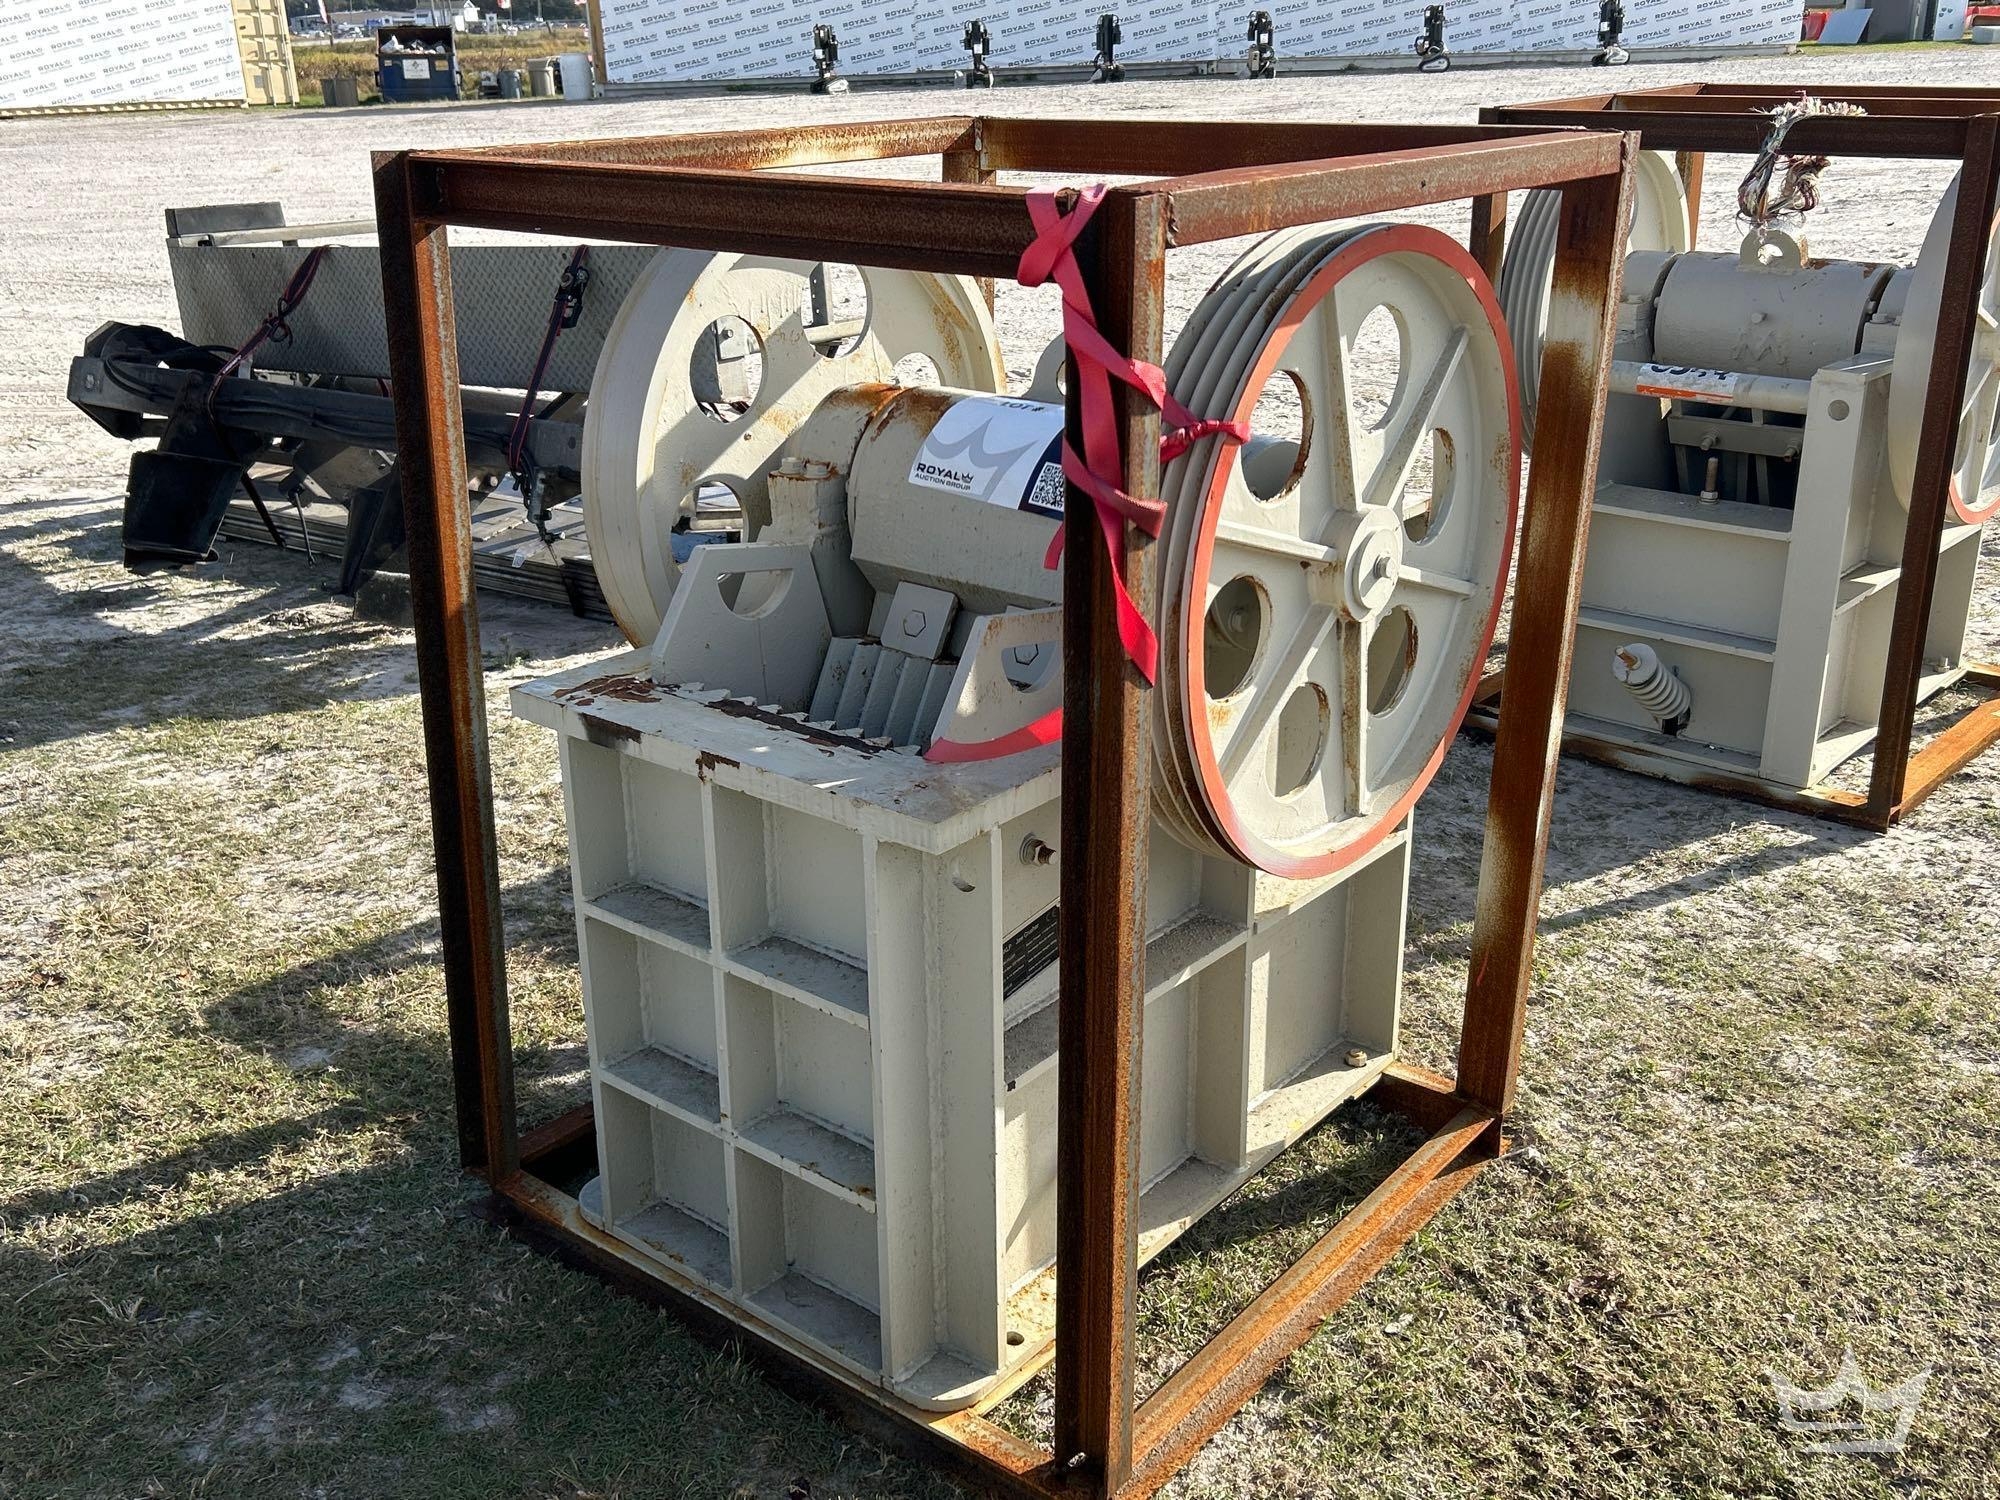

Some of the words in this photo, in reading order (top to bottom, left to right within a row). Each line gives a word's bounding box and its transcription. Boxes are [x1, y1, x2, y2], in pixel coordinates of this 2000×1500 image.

[917, 462, 960, 481] ROYAL
[915, 473, 944, 485] AUCTION
[946, 480, 971, 490] GROUP
